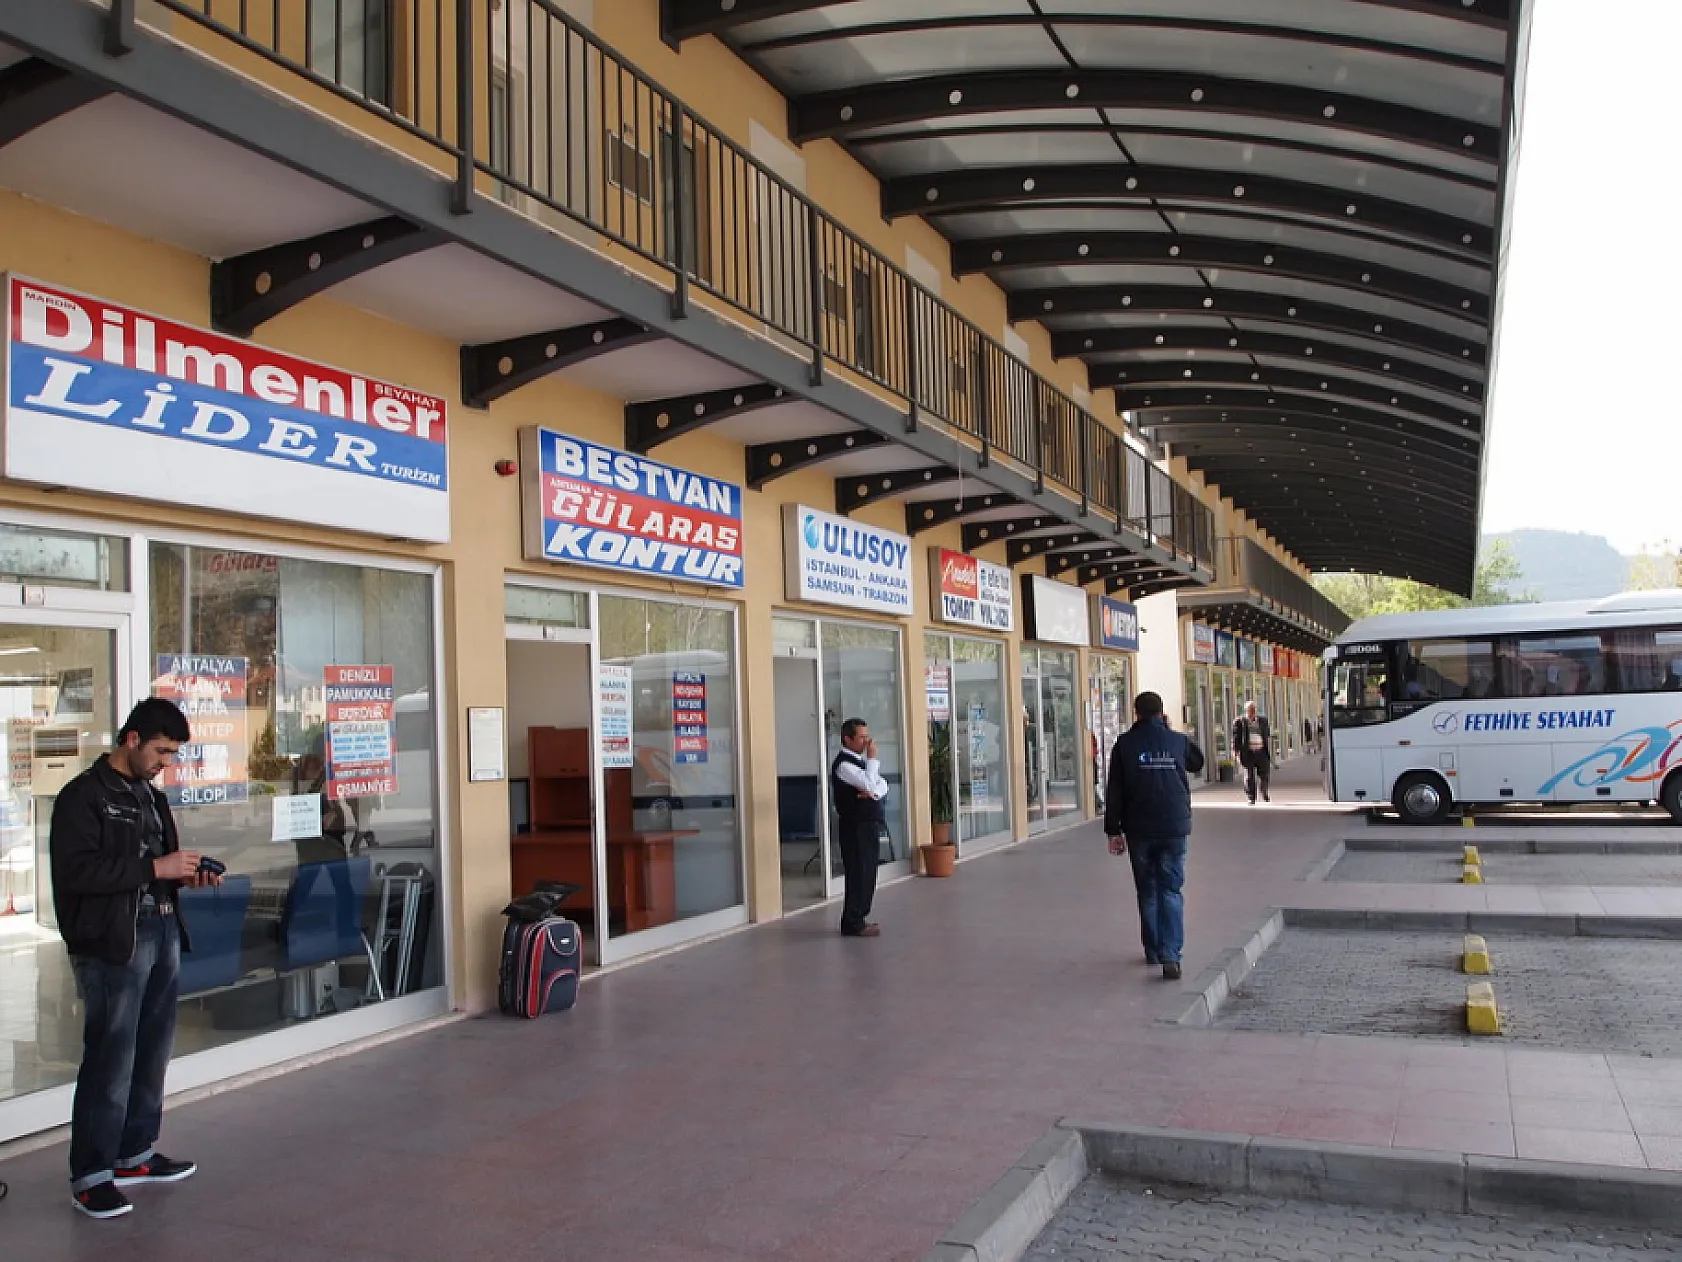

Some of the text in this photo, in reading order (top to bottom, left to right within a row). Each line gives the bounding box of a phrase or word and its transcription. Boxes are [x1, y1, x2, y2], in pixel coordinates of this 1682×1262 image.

[19, 285, 441, 439] Dilmenler
[374, 383, 437, 408] SEYAHAT
[24, 356, 378, 472] LİDER
[555, 437, 732, 514] BESTVAN
[552, 488, 739, 551] GÜLARAS
[547, 523, 743, 582] KONTUR
[823, 521, 908, 571] ULUSOY
[807, 576, 855, 597] SAMSUN
[863, 586, 908, 605] TRABZON
[869, 571, 908, 590] ANKARA
[171, 656, 235, 675] ANTALYA
[327, 686, 393, 701] PAMUKKALE
[188, 722, 235, 738] ANTEP
[1464, 709, 1616, 732] FETHİYE SEYAHAT
